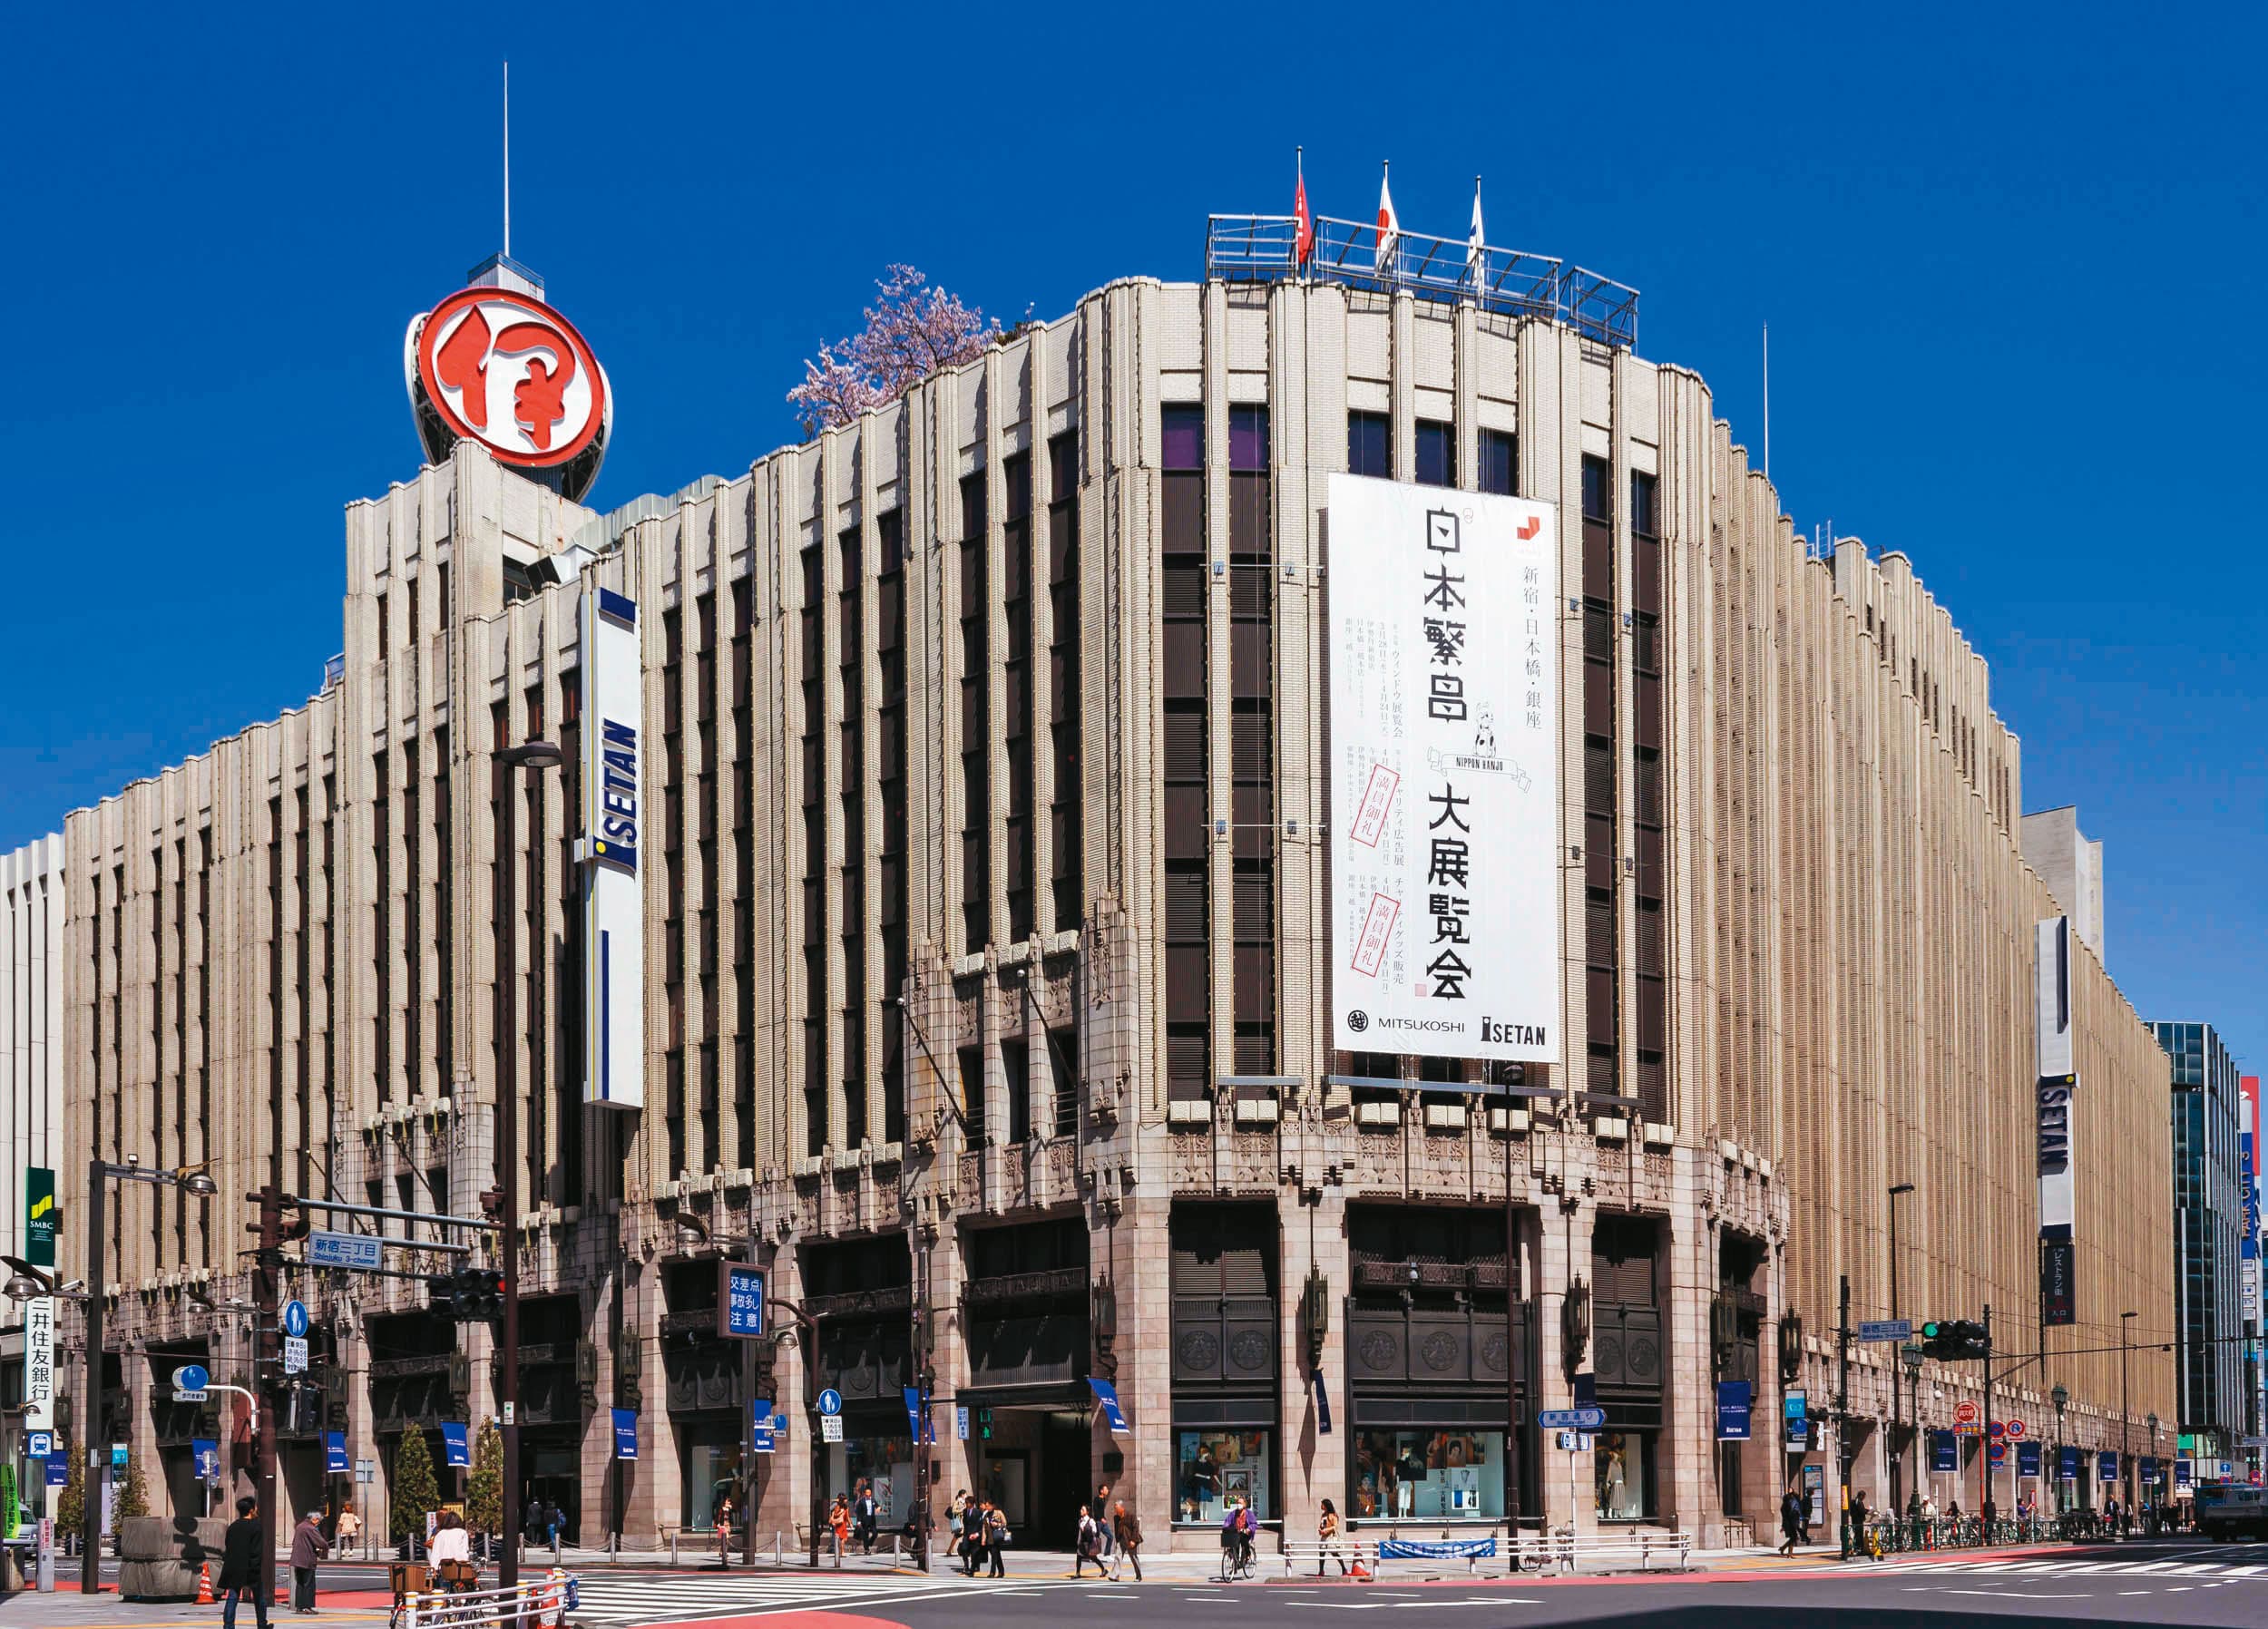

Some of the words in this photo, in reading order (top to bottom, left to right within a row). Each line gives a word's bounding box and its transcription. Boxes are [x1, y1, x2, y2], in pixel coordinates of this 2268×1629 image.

[1456, 756, 1480, 769] NIPPON
[1425, 782, 1471, 1001] 大展覧会
[1393, 877, 1404, 985] チャティグッズ販売
[1378, 1018, 1465, 1033] MITSUKOSHI
[1481, 1016, 1546, 1045] ISETAN
[30, 1220, 54, 1230] SMBC
[316, 1239, 376, 1256] 新宿三丁目
[314, 1253, 343, 1263] Shinjuku
[345, 1255, 376, 1264] 3-chome
[730, 1276, 760, 1292] 交差点
[730, 1293, 759, 1310] 事故多し
[730, 1312, 758, 1328] 注意
[1862, 1323, 1908, 1334] 新宿三丁目
[32, 1295, 50, 1400] 三井住友銀行
